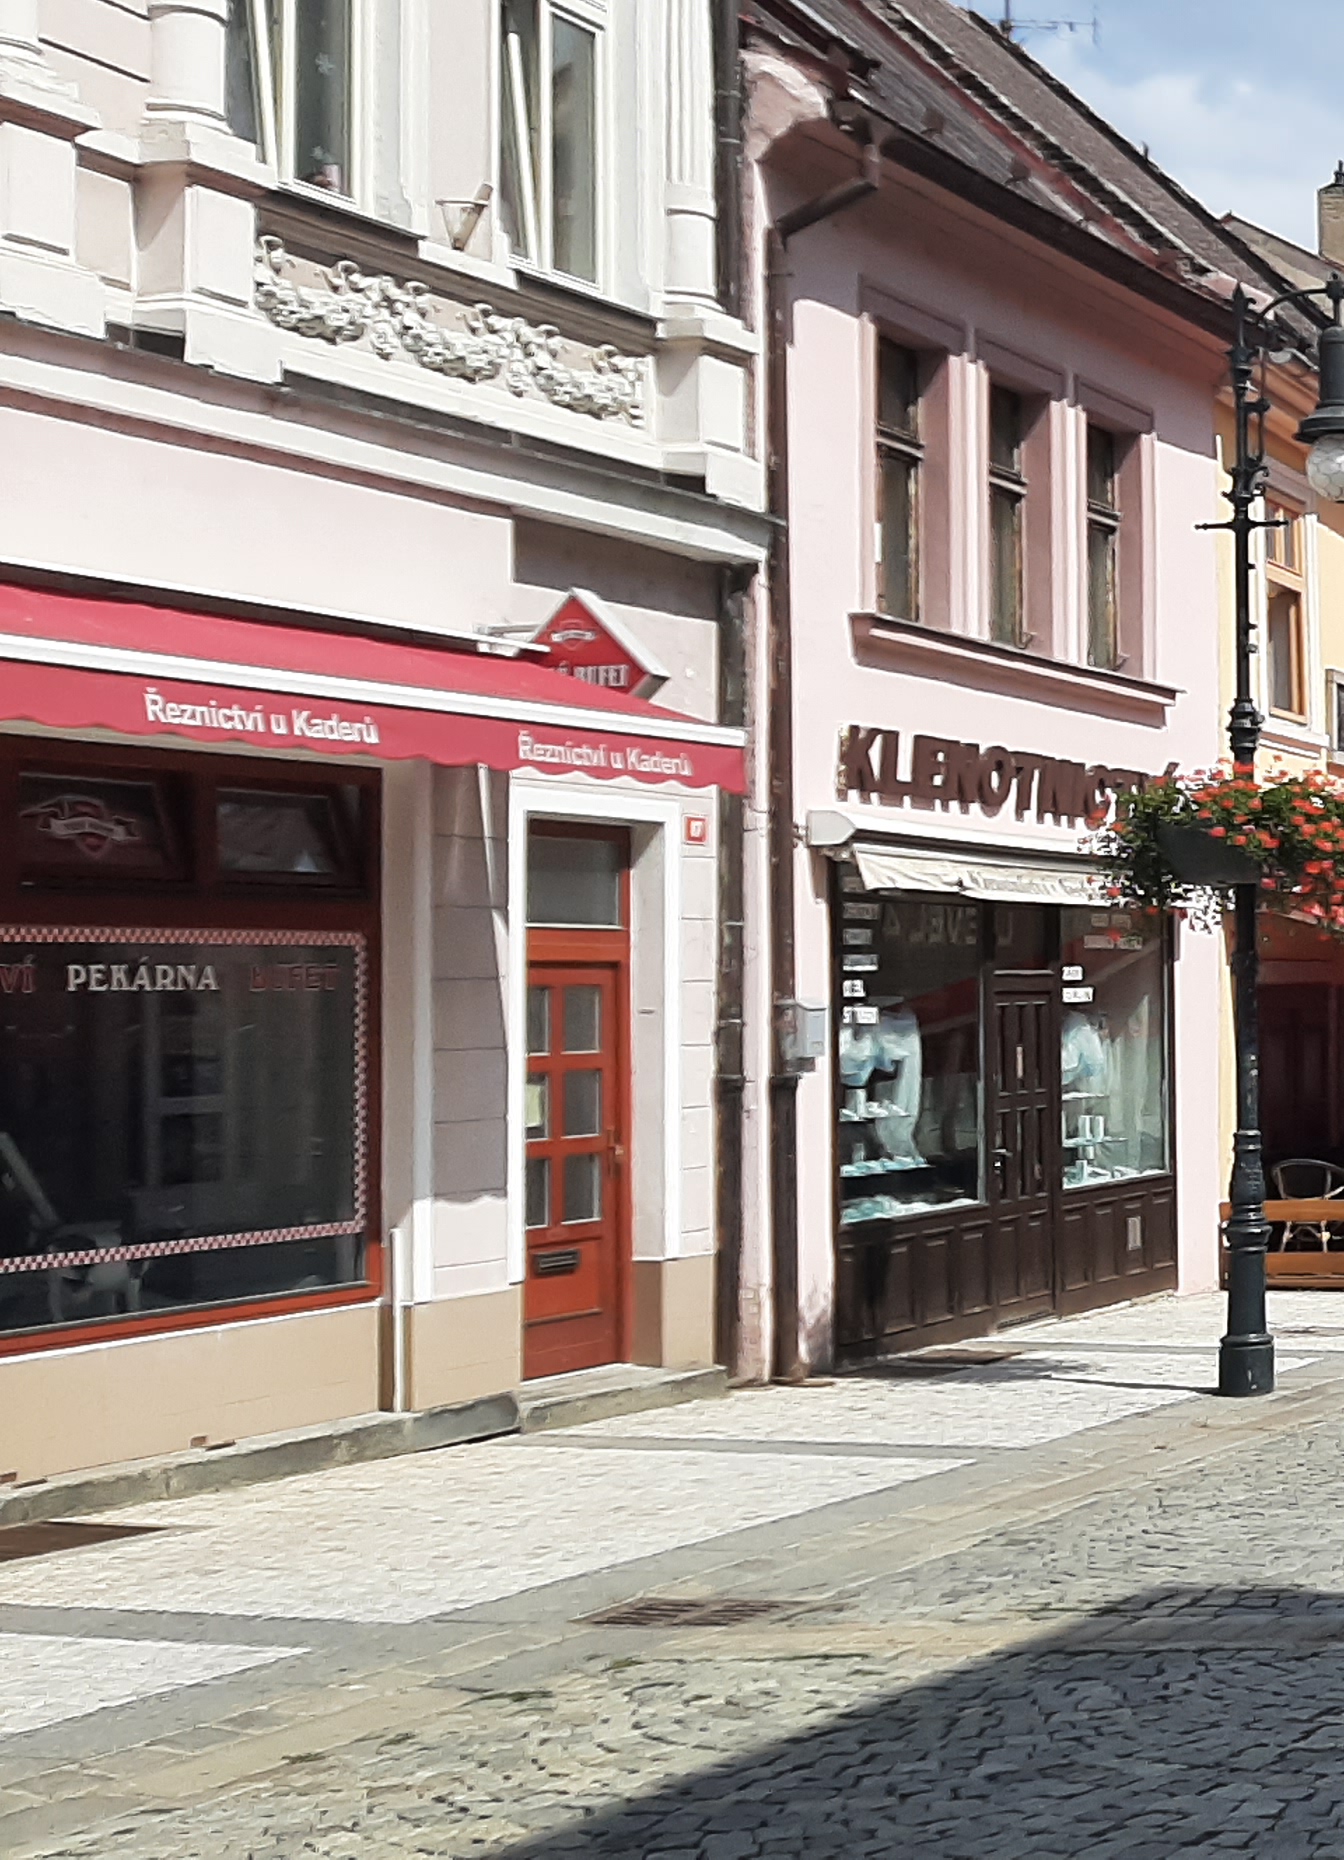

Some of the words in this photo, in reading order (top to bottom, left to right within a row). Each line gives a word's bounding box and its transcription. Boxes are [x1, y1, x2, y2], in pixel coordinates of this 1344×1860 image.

[144, 687, 265, 732] Řeznictví
[271, 714, 288, 735] u
[292, 709, 380, 744] Kaderů
[518, 730, 608, 767] Řeznictví
[610, 751, 625, 769] u
[627, 747, 693, 776] Kaderů
[837, 724, 1180, 828] KLENOTNICT
[66, 956, 220, 992] PEKÁRNA
